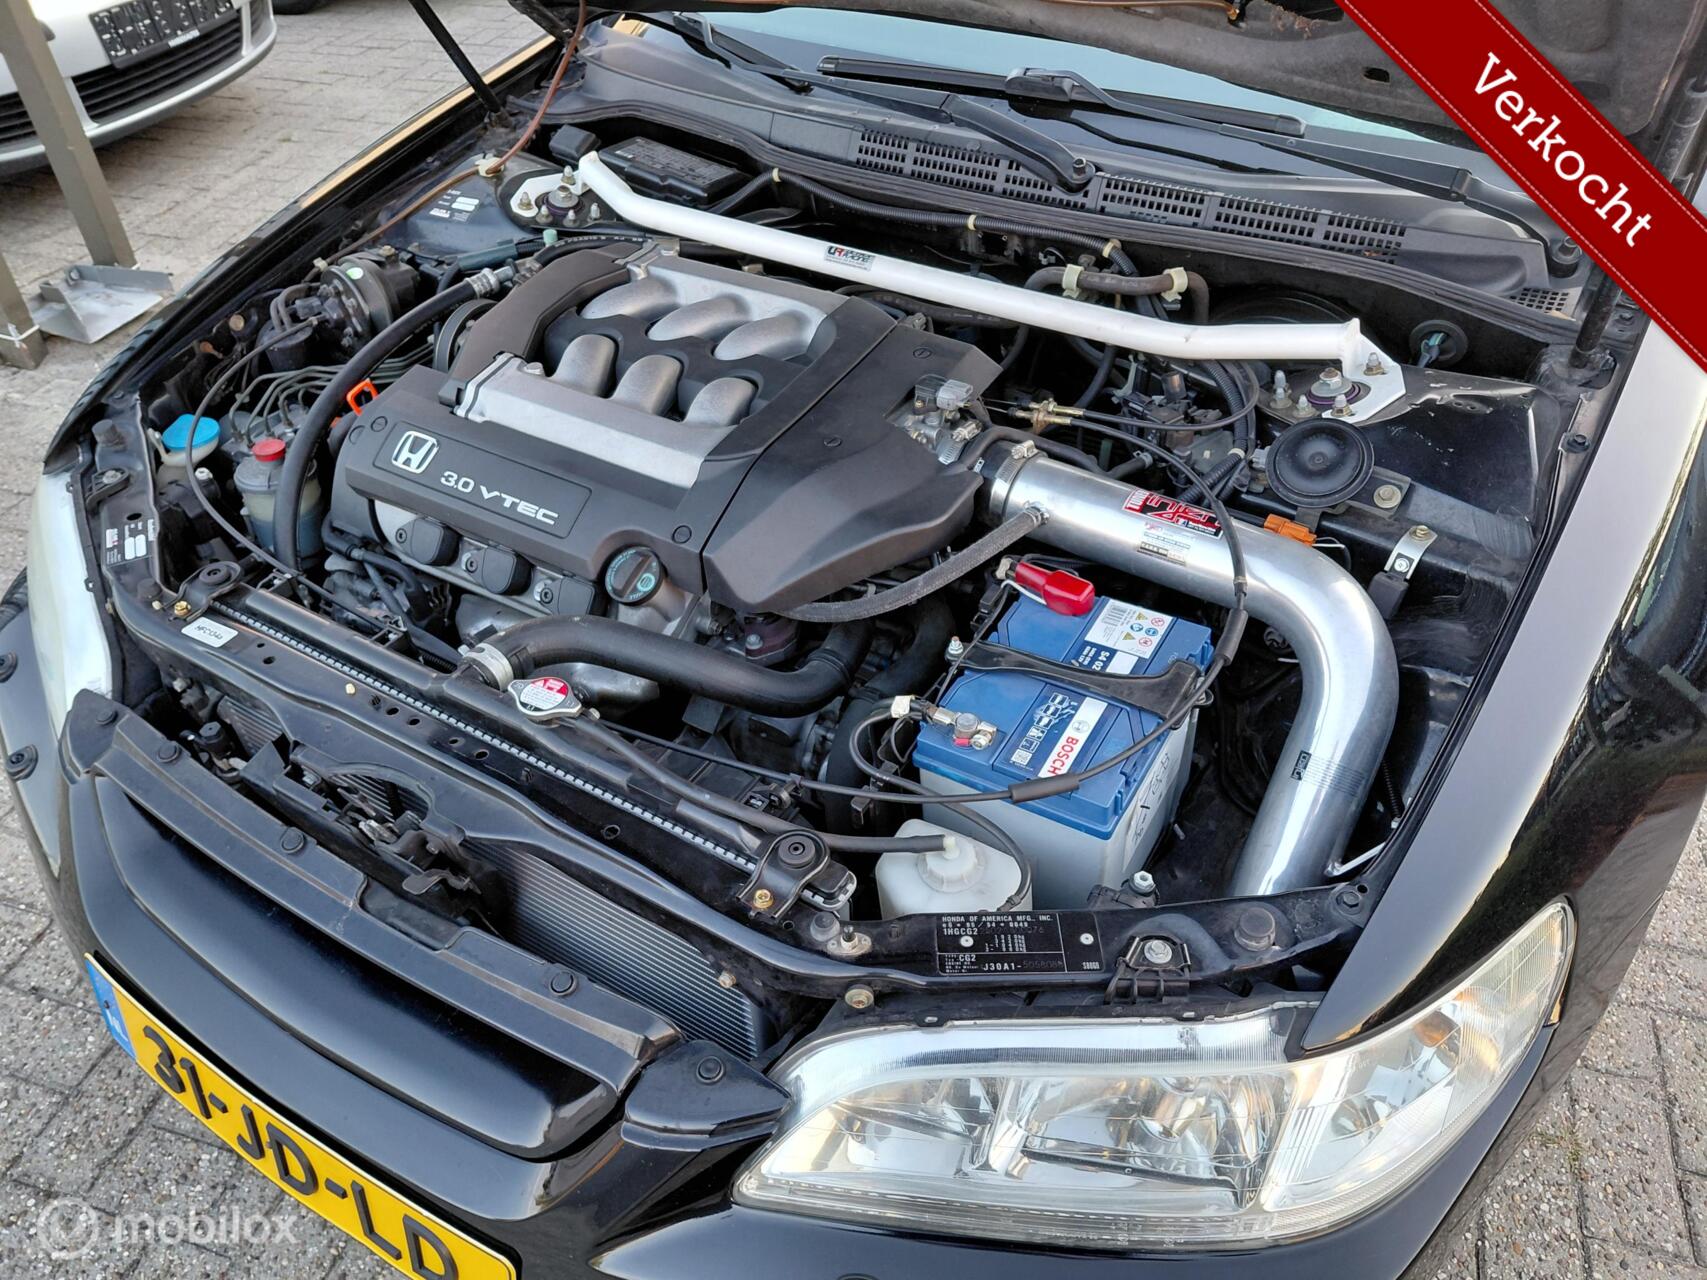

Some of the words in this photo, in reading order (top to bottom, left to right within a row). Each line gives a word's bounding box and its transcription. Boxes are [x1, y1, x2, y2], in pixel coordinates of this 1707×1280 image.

[440, 471, 475, 493] 3.0
[479, 485, 559, 525] VTEC
[1047, 736, 1080, 776] BOSCH
[959, 954, 976, 962] CG2
[142, 1025, 459, 1280] 31-JD-LD
